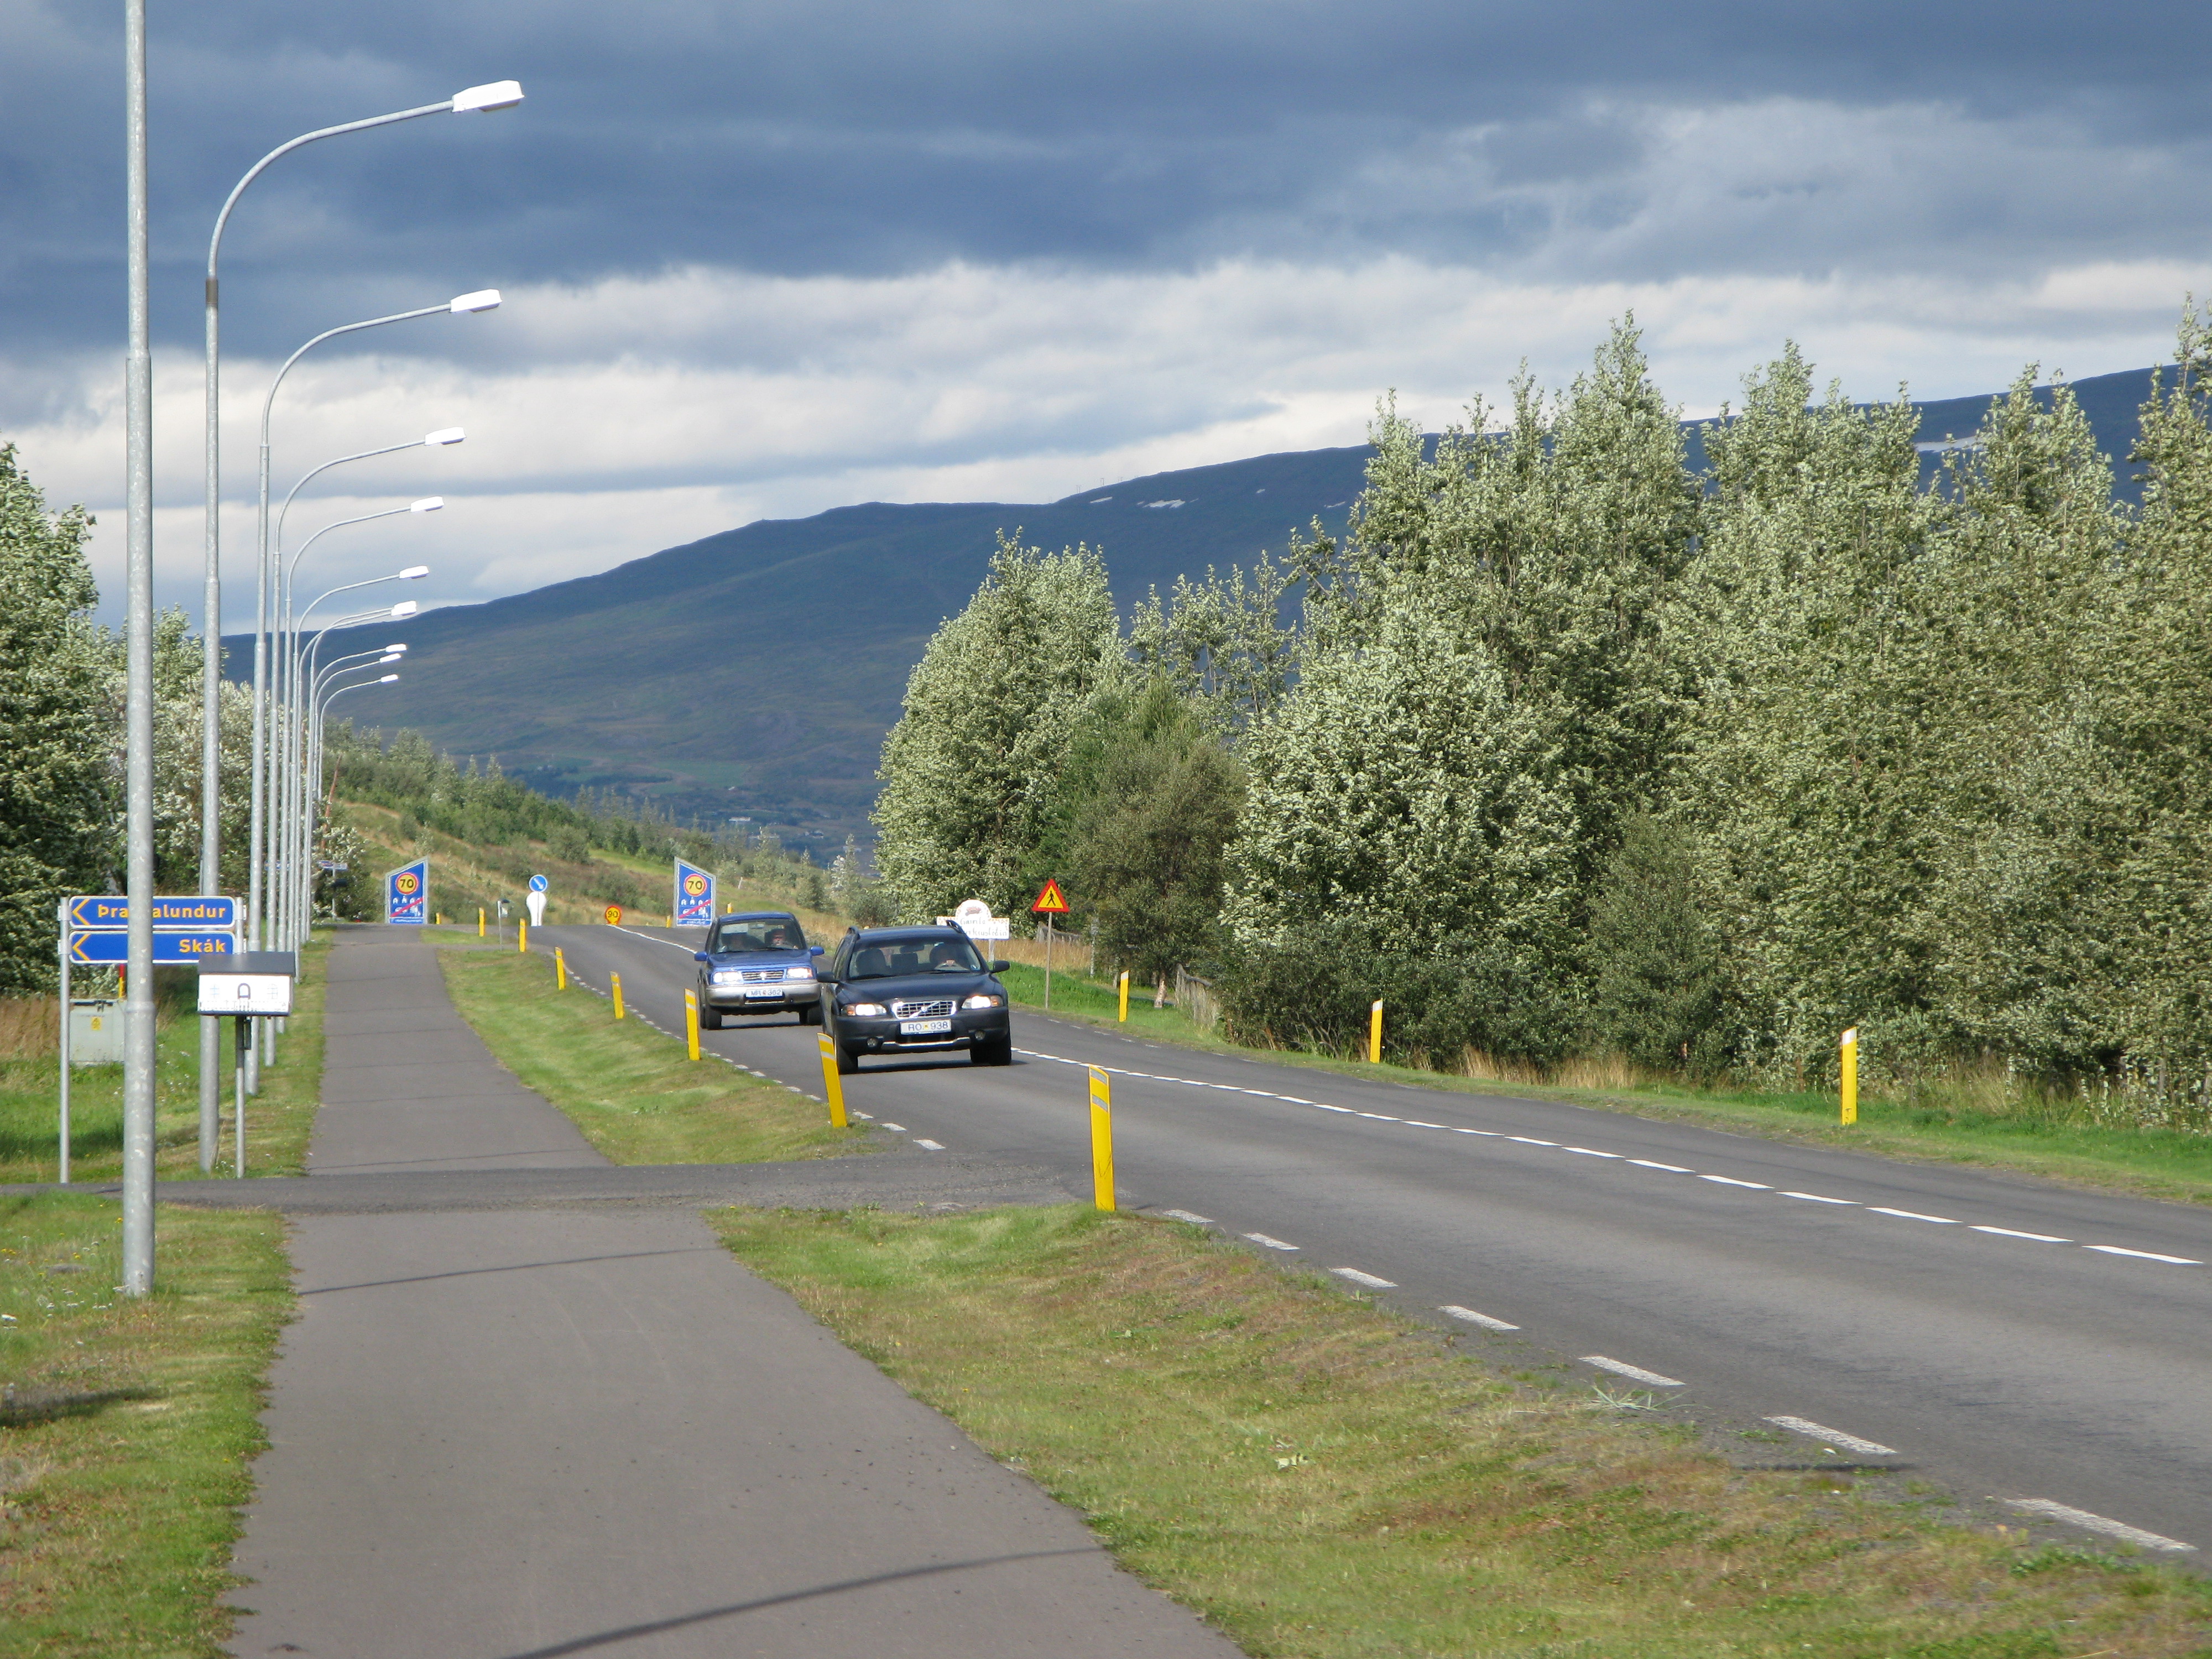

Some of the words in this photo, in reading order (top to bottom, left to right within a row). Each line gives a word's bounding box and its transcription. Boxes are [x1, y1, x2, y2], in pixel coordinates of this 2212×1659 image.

[400, 879, 414, 888] 70
[687, 880, 703, 890] 70
[97, 904, 226, 919] Þraalundur
[179, 938, 226, 953] Skák
[908, 1023, 922, 1031] RO
